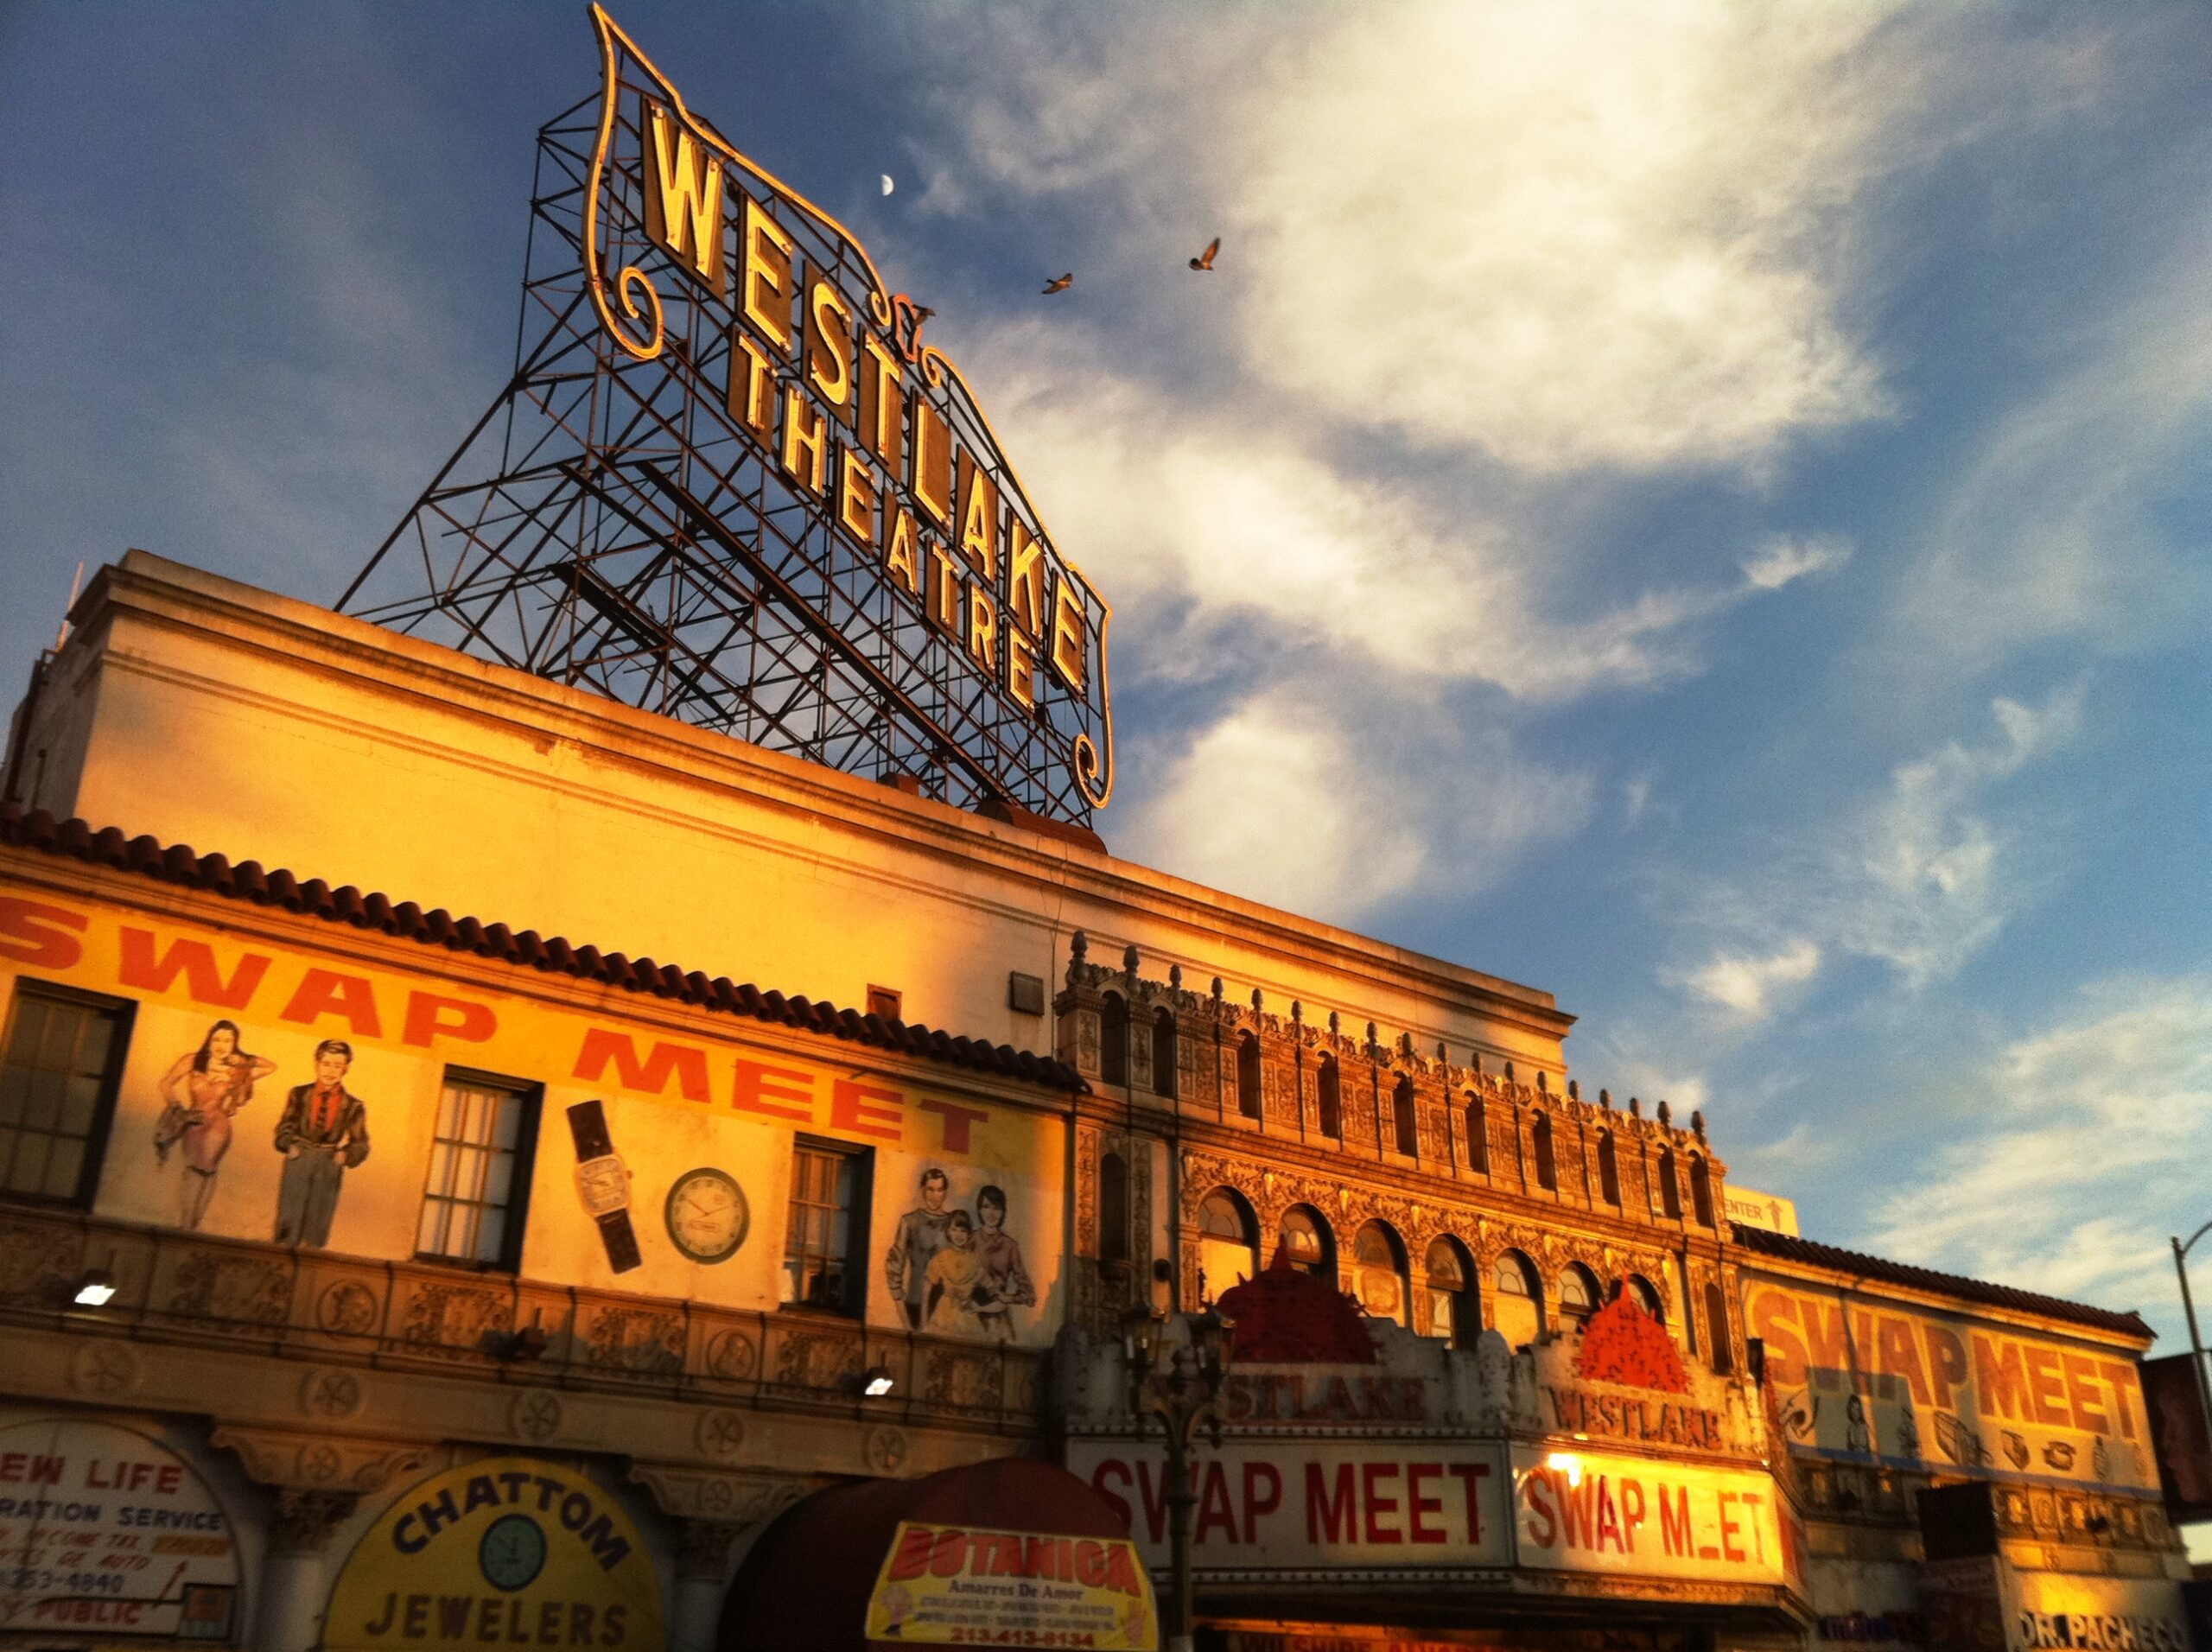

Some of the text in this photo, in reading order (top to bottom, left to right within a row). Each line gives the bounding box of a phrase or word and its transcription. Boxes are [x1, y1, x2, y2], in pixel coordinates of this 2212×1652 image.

[651, 104, 1086, 692] WESTLAKE
[739, 336, 1035, 711] THEATRE
[0, 896, 988, 1155] SWAP MEET
[1751, 1291, 2139, 1439] SWAP MEET
[1550, 1387, 1722, 1450] WESTLAKE
[86, 1459, 183, 1494] LIFE
[118, 1506, 222, 1530] SERVICE
[1305, 1462, 1490, 1545] MEET
[1527, 1466, 1646, 1554] SWAP
[392, 1472, 632, 1573] CHATTOM
[886, 1528, 1141, 1597] BOTANICA
[365, 1592, 628, 1646] JEWELERS
[1018, 1584, 1038, 1597] De
[1042, 1585, 1084, 1600] Amor
